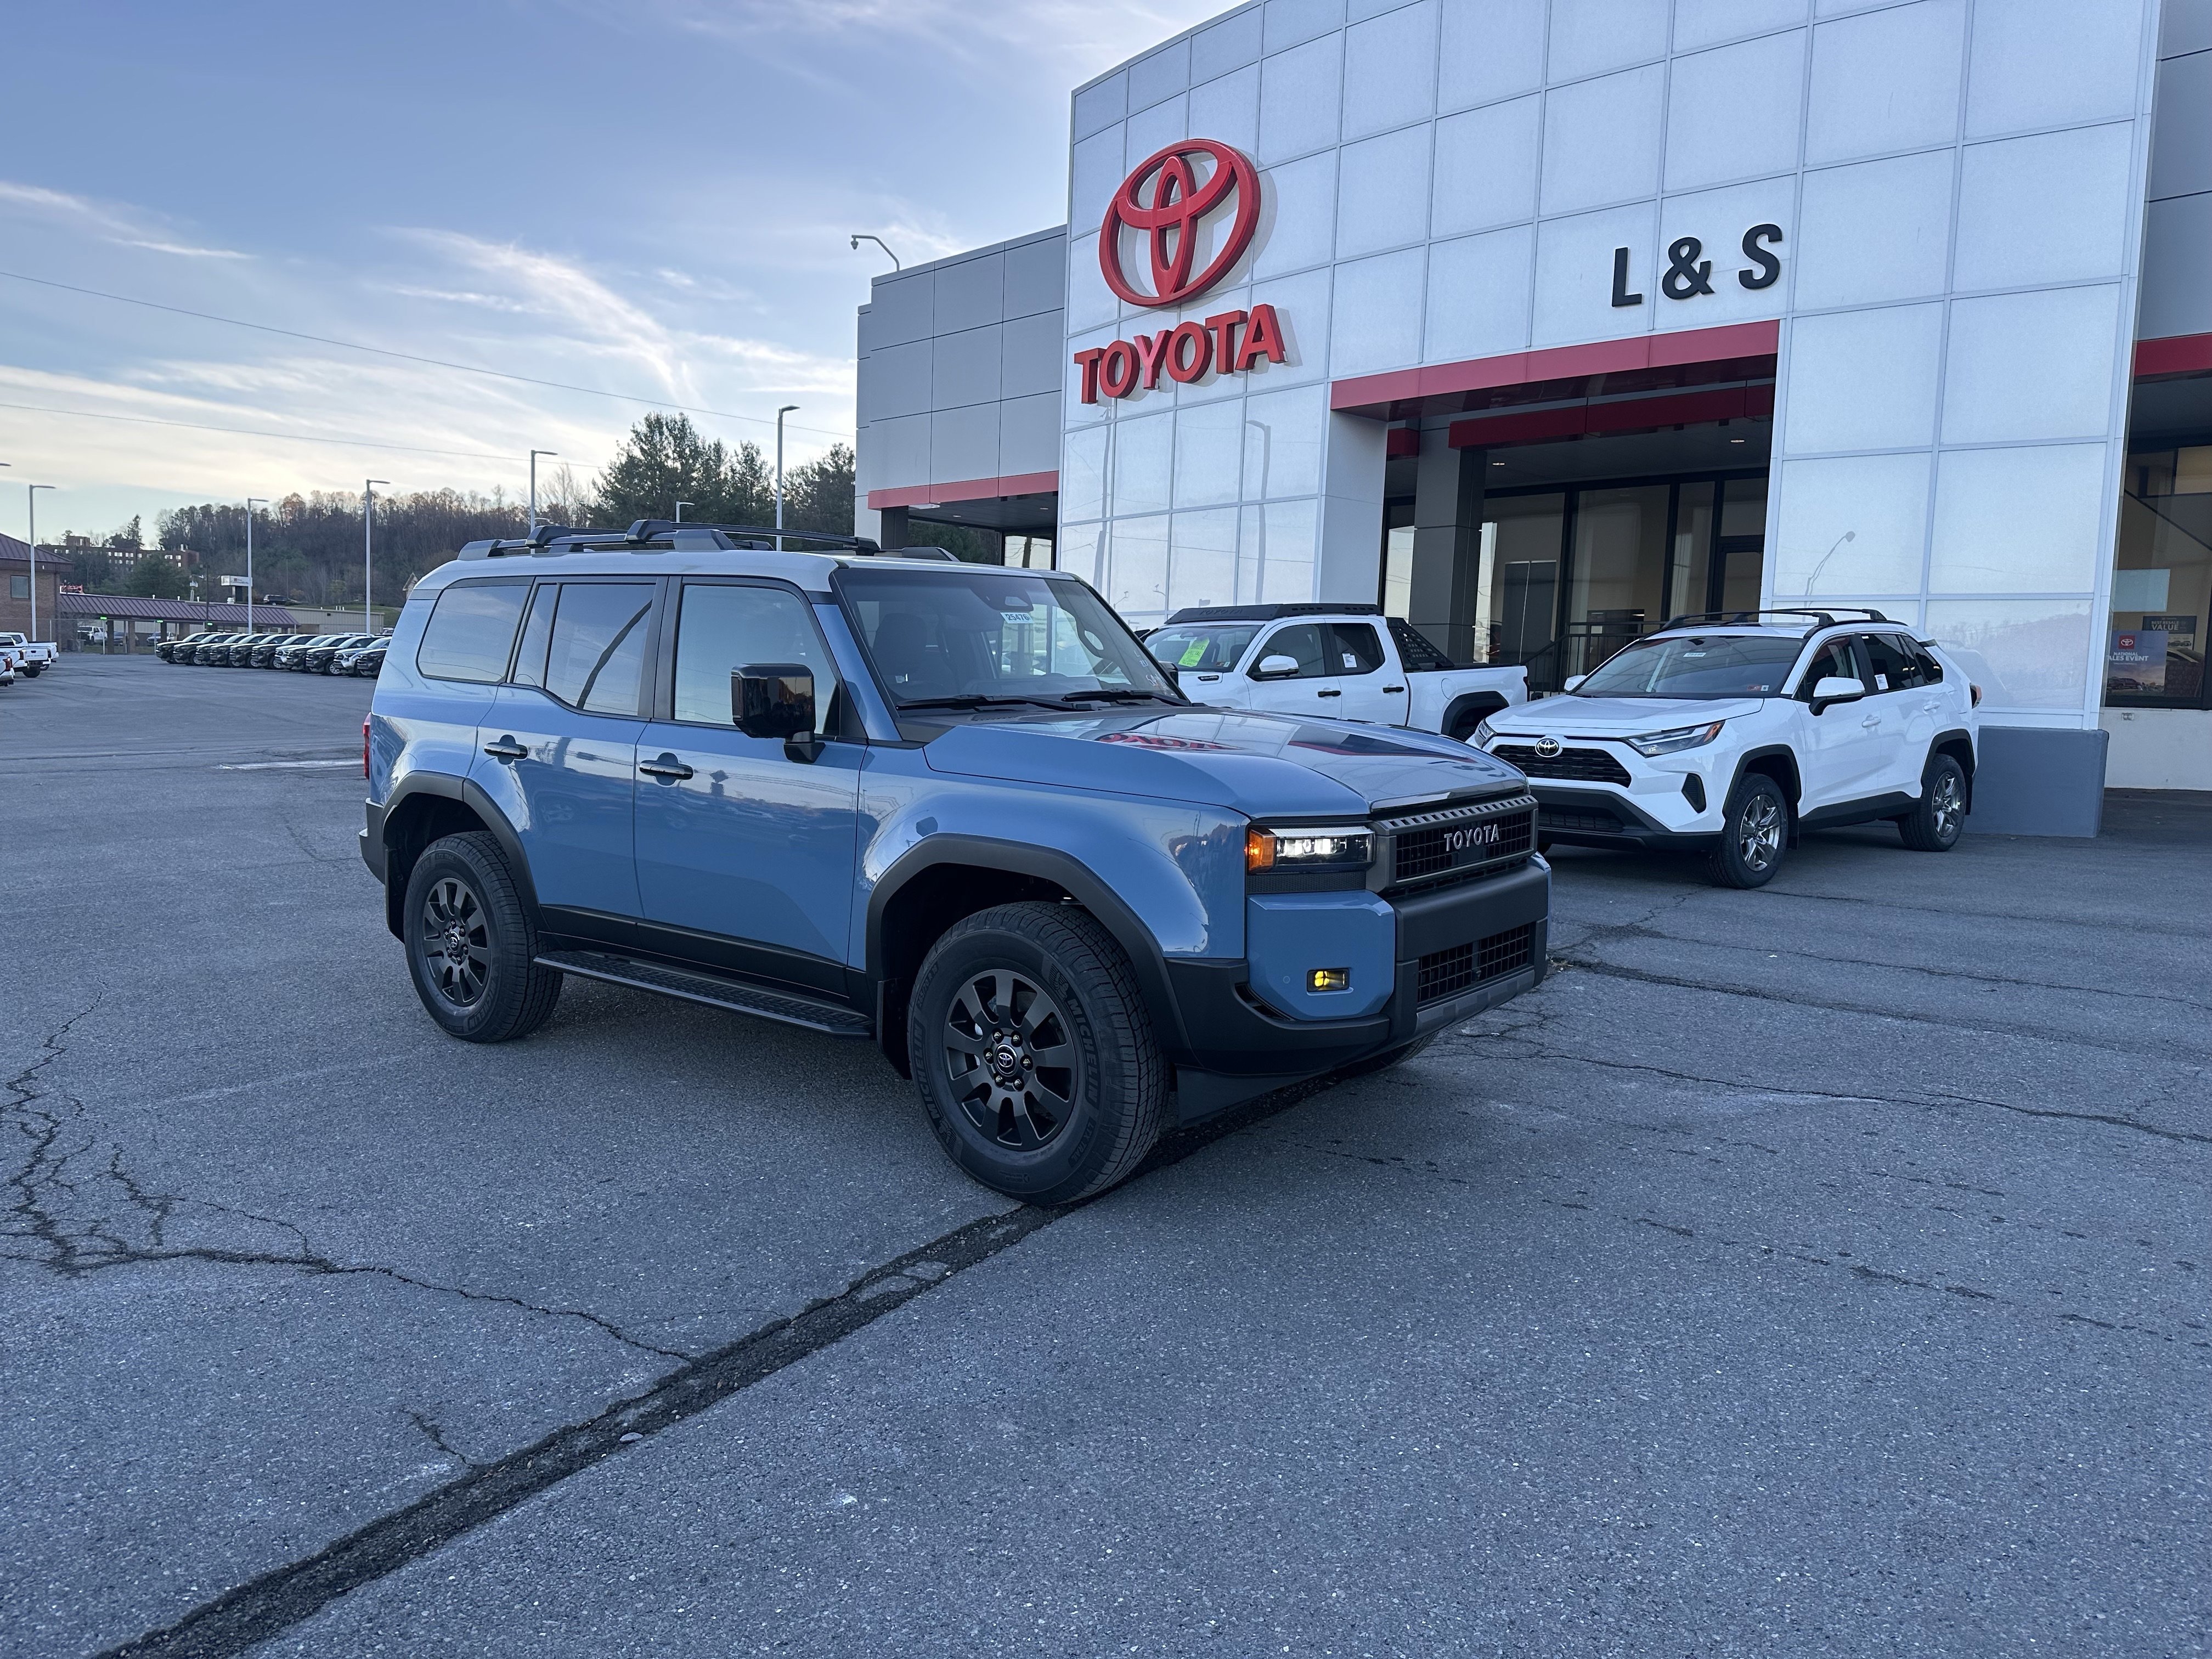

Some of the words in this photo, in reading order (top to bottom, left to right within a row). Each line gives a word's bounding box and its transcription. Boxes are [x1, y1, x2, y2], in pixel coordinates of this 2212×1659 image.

[1612, 247, 1642, 307] L
[1662, 236, 1715, 300] &
[1739, 223, 1783, 290] S
[1074, 303, 1288, 404] TOYOTA
[1444, 823, 1499, 851] TOYOTA
[914, 1018, 940, 1119] MICHELIN
[1067, 998, 1098, 1103] MICHELIN
